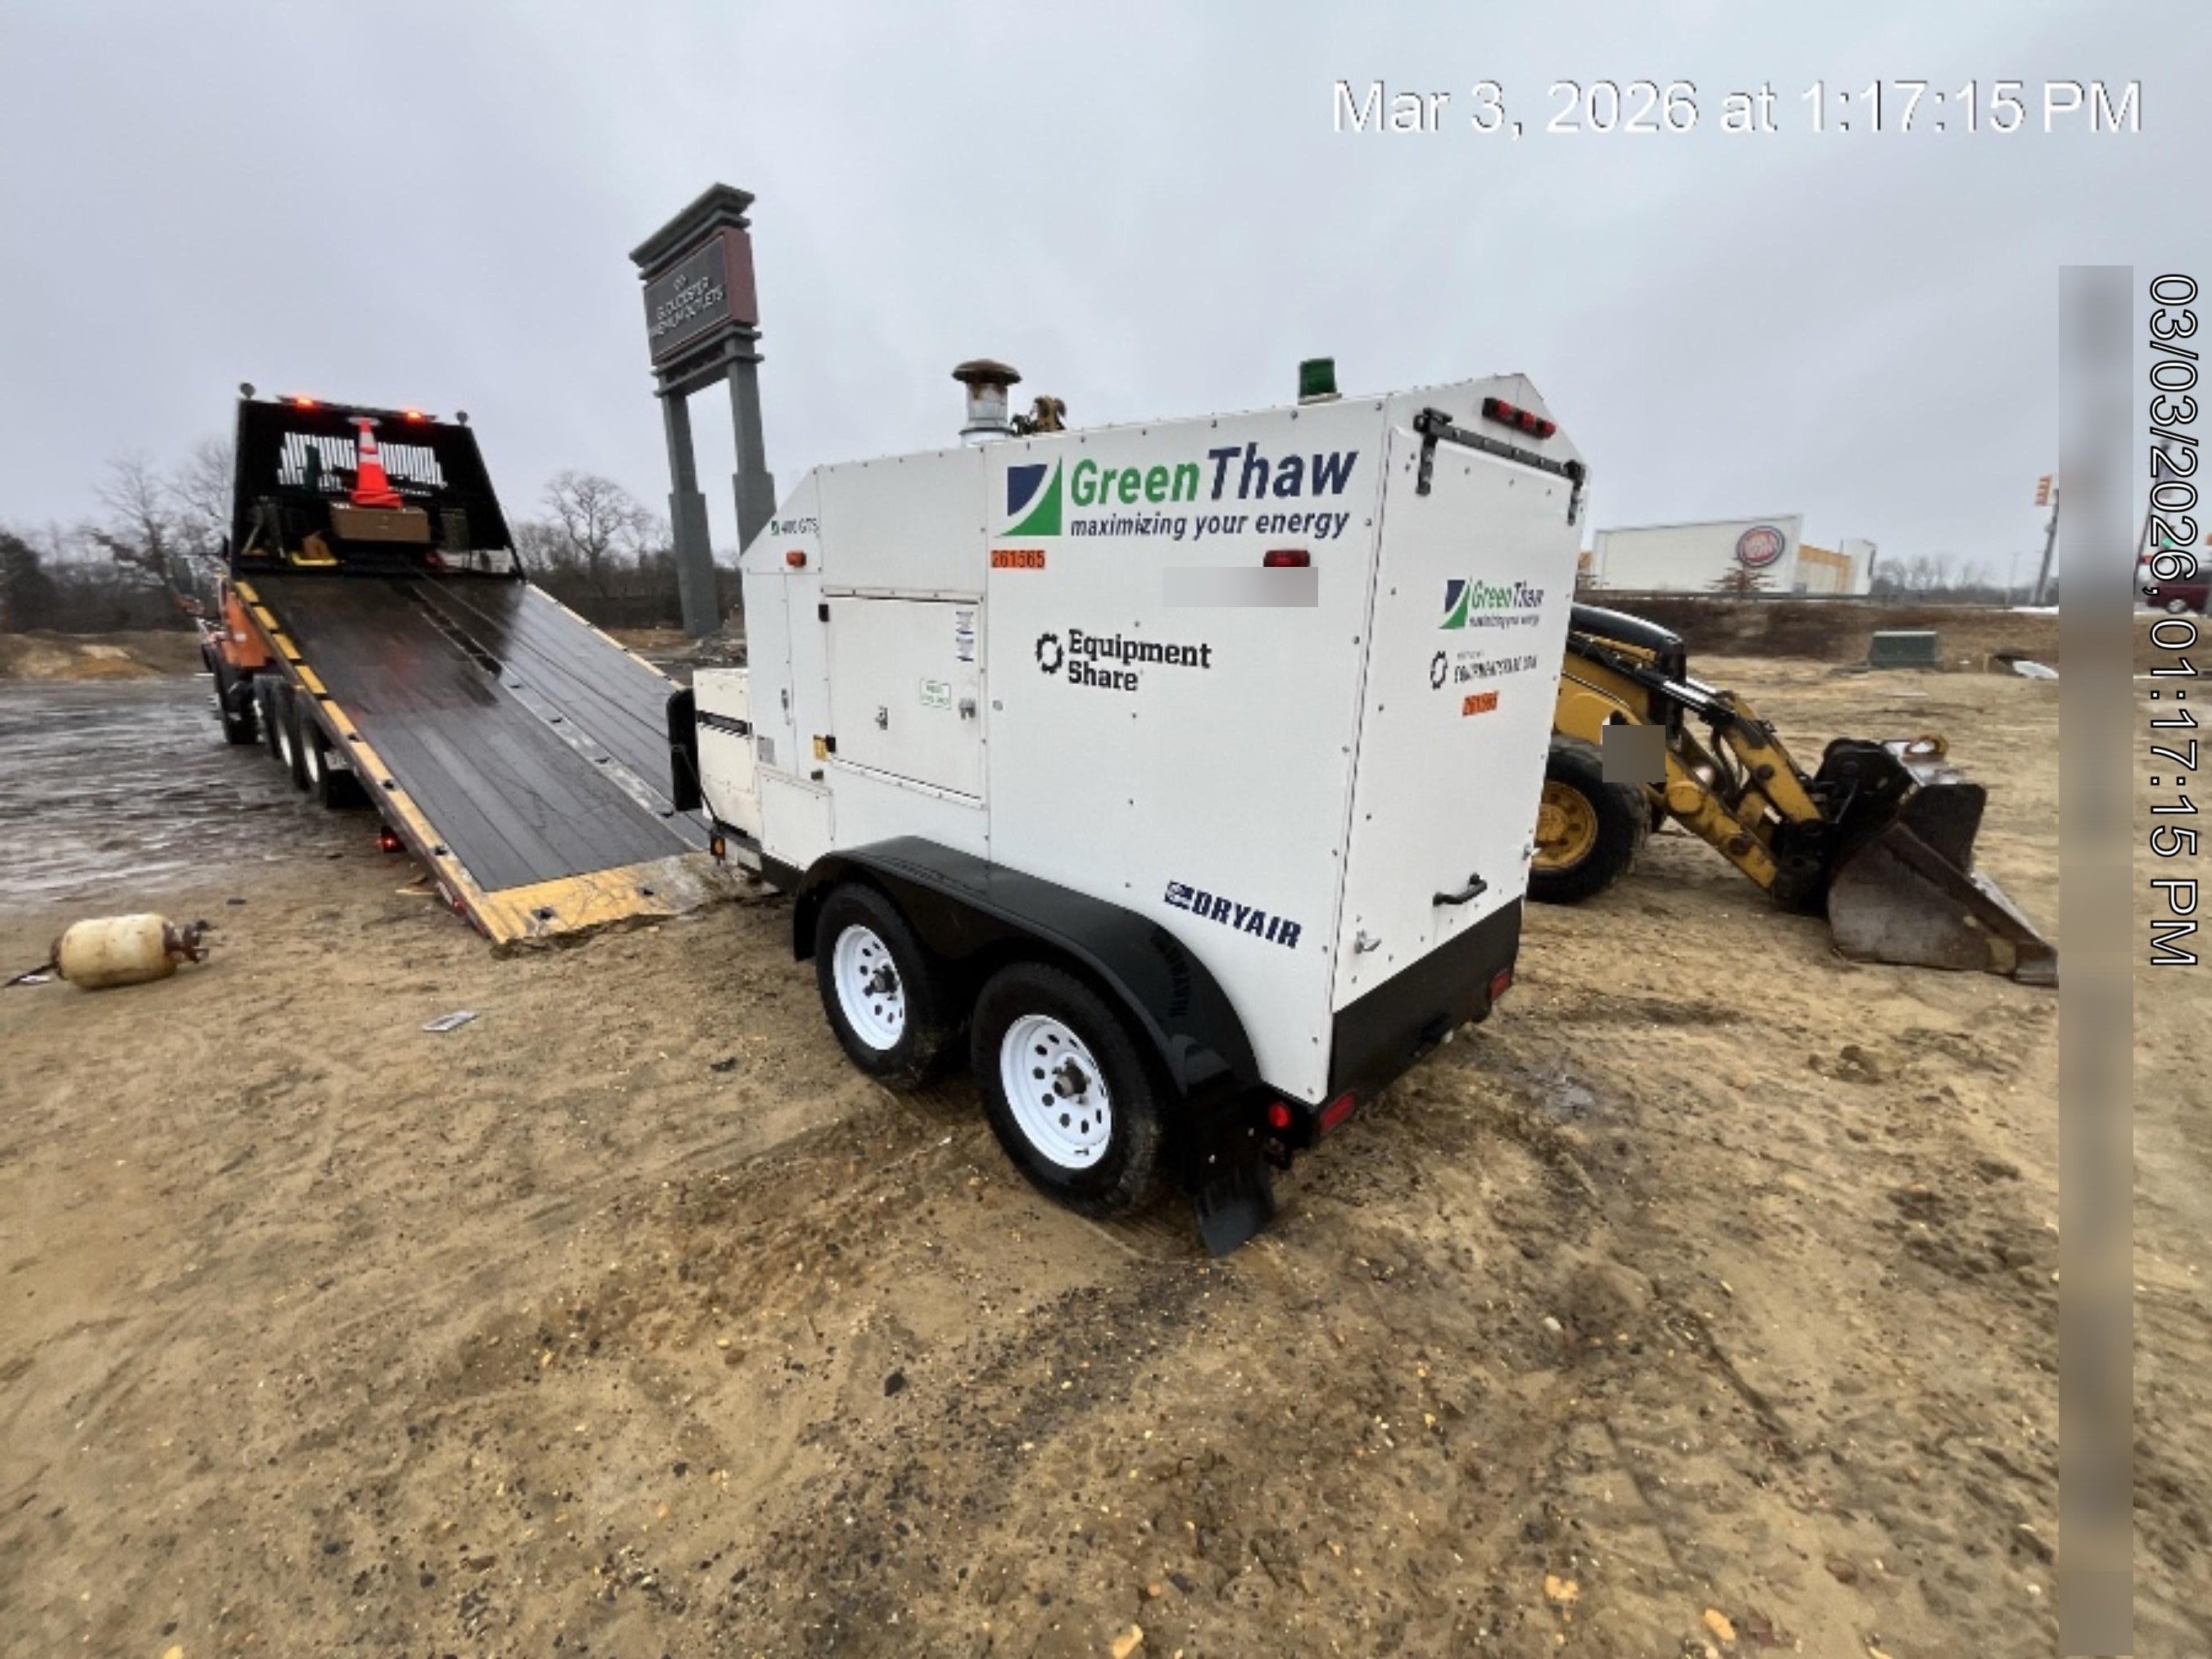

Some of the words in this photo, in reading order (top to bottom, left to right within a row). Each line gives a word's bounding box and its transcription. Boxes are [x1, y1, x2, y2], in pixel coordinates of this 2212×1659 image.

[1071, 510, 1187, 542] maximizing
[1193, 514, 1249, 542] your
[1255, 512, 1350, 540] energy
[1068, 628, 1213, 669] Equipment
[1068, 660, 1139, 691] Share
[1192, 889, 1303, 950] DRYAIR
